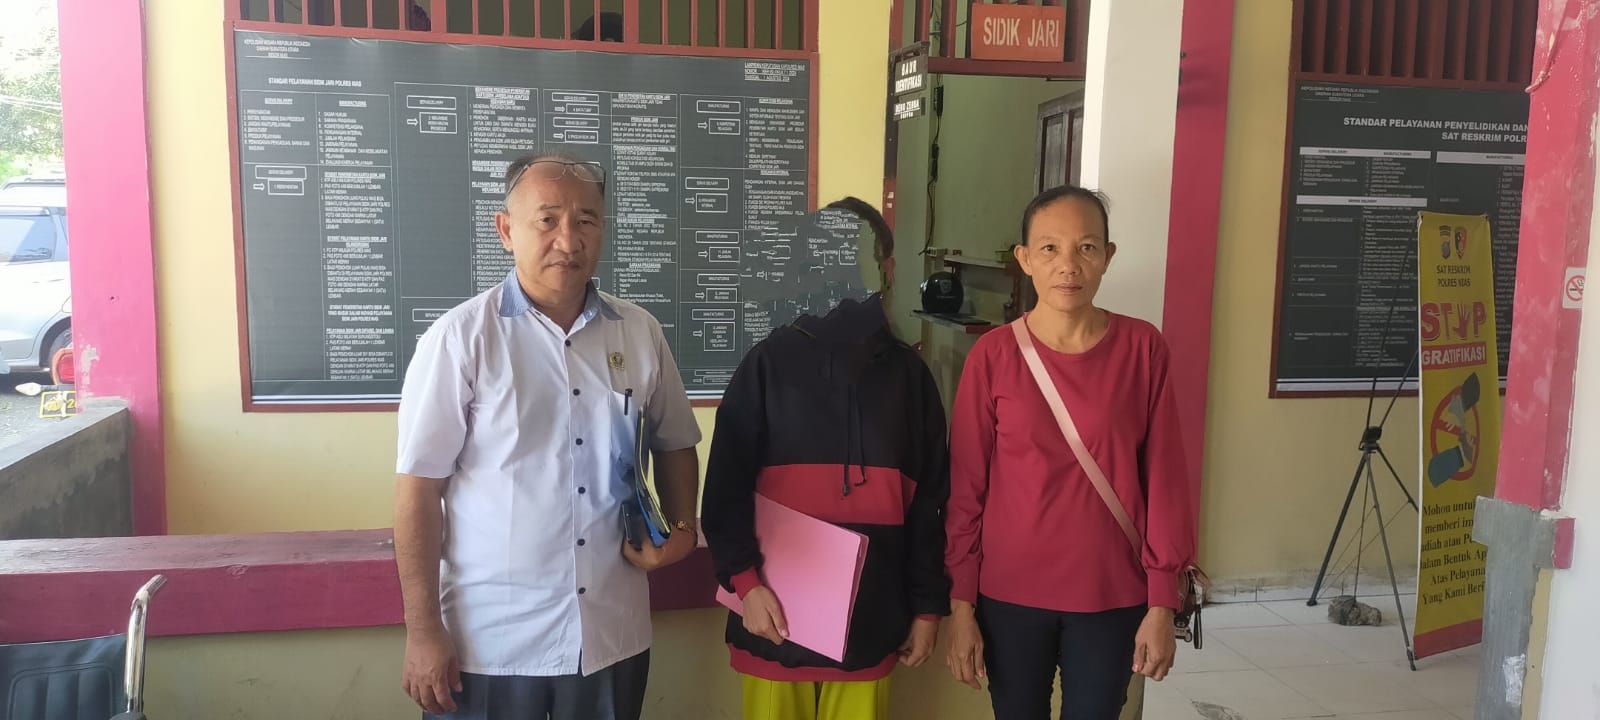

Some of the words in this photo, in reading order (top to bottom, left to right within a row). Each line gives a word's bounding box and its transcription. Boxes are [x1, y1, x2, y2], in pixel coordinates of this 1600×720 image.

[983, 16, 1021, 47] SIDIK
[1027, 19, 1060, 48] JARI
[1343, 117, 1388, 127] STANDAR
[1388, 118, 1442, 129] PELAYANAN
[1444, 120, 1511, 131] PENYELIDIKAN
[1441, 131, 1459, 141] SAT
[1460, 132, 1502, 142] RESKRIM
[1436, 264, 1447, 274] SAT
[1447, 265, 1471, 274] RESKRIM
[1437, 278, 1457, 288] POLRES
[1458, 277, 1471, 287] NIAS
[1422, 344, 1485, 366] GRATIFIKASI
[1423, 503, 1451, 516] Mohon
[1425, 517, 1460, 534] memberi
[1443, 537, 1461, 548] atau
[1443, 550, 1472, 565] Bentuk
[1430, 574, 1449, 586] Atas
[1422, 592, 1443, 605] Yang
[1444, 587, 1466, 600] Kami
